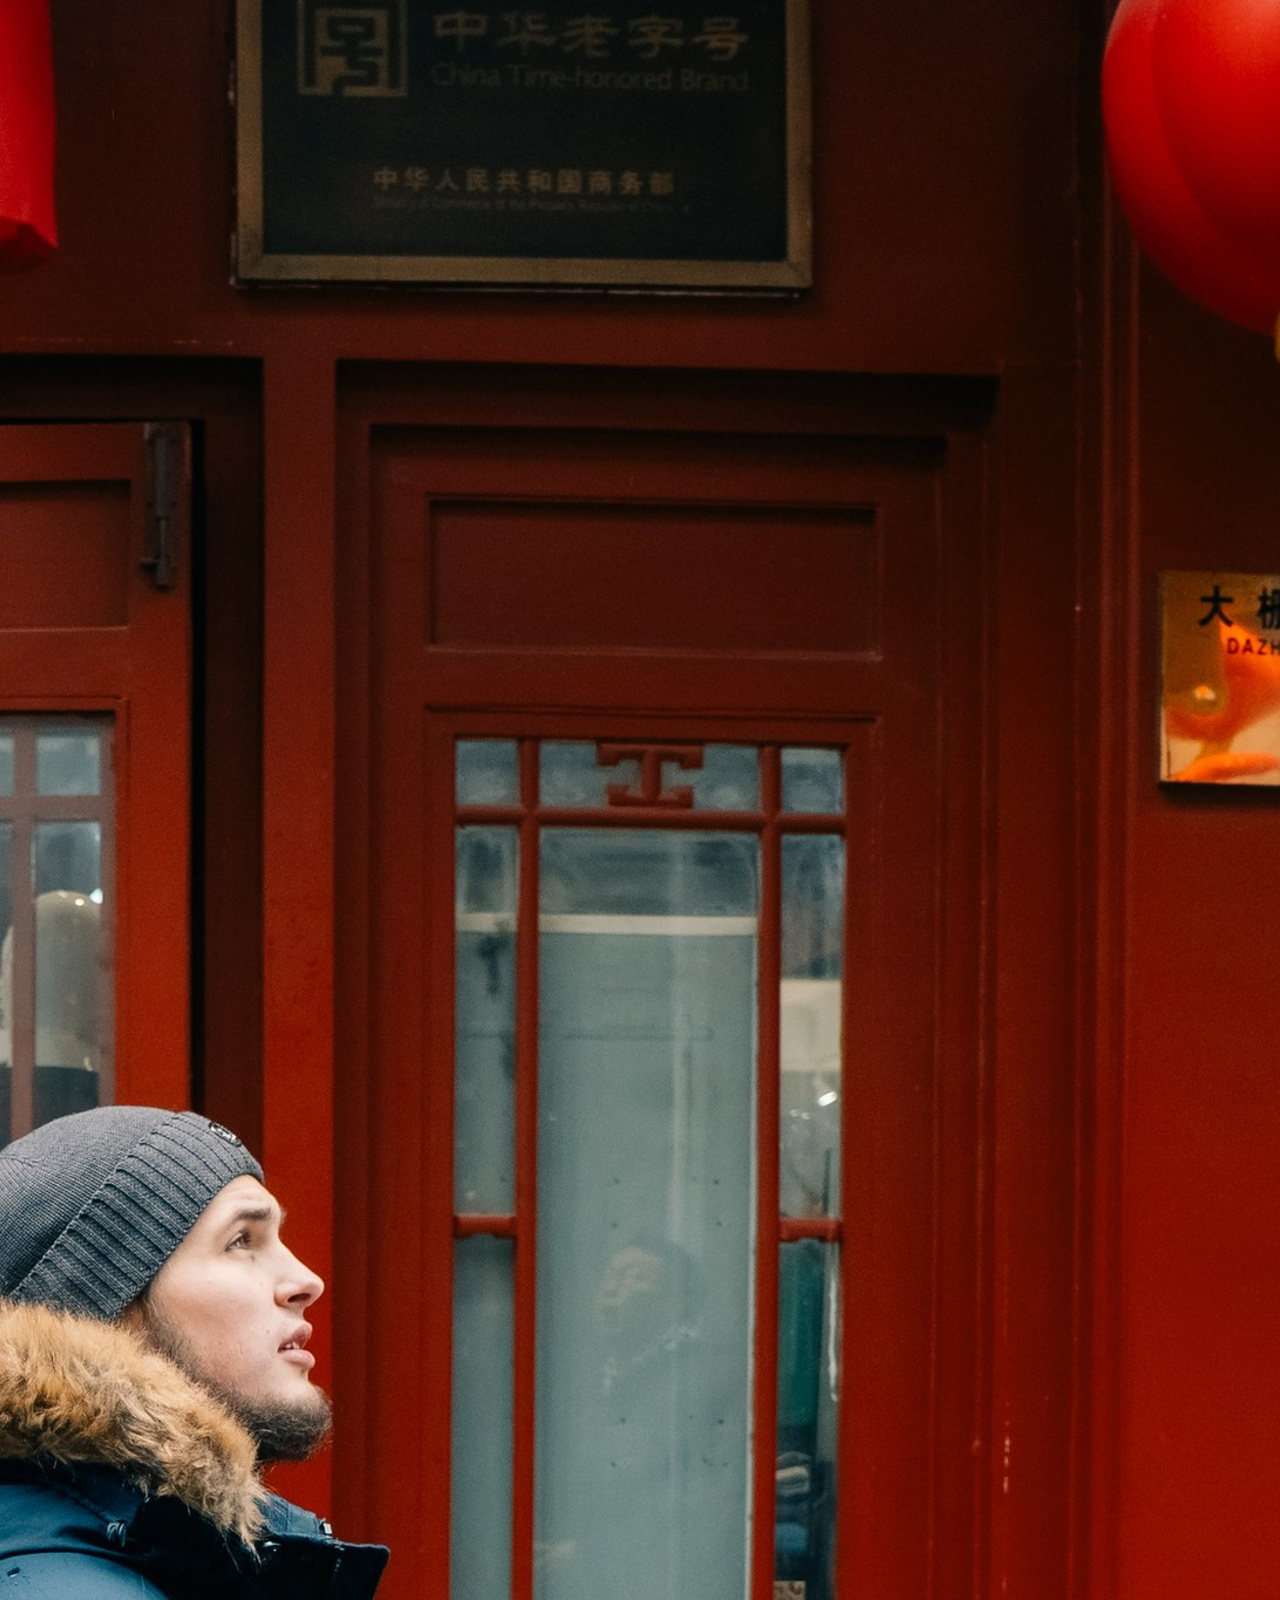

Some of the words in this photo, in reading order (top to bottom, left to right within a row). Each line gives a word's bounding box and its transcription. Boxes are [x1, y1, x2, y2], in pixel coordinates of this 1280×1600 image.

[433, 10, 749, 62] 中华老字号
[431, 63, 501, 88] China
[510, 63, 672, 91] Time-honored
[680, 66, 749, 93] Brand
[373, 167, 675, 196] 中华人民共和国商务部
